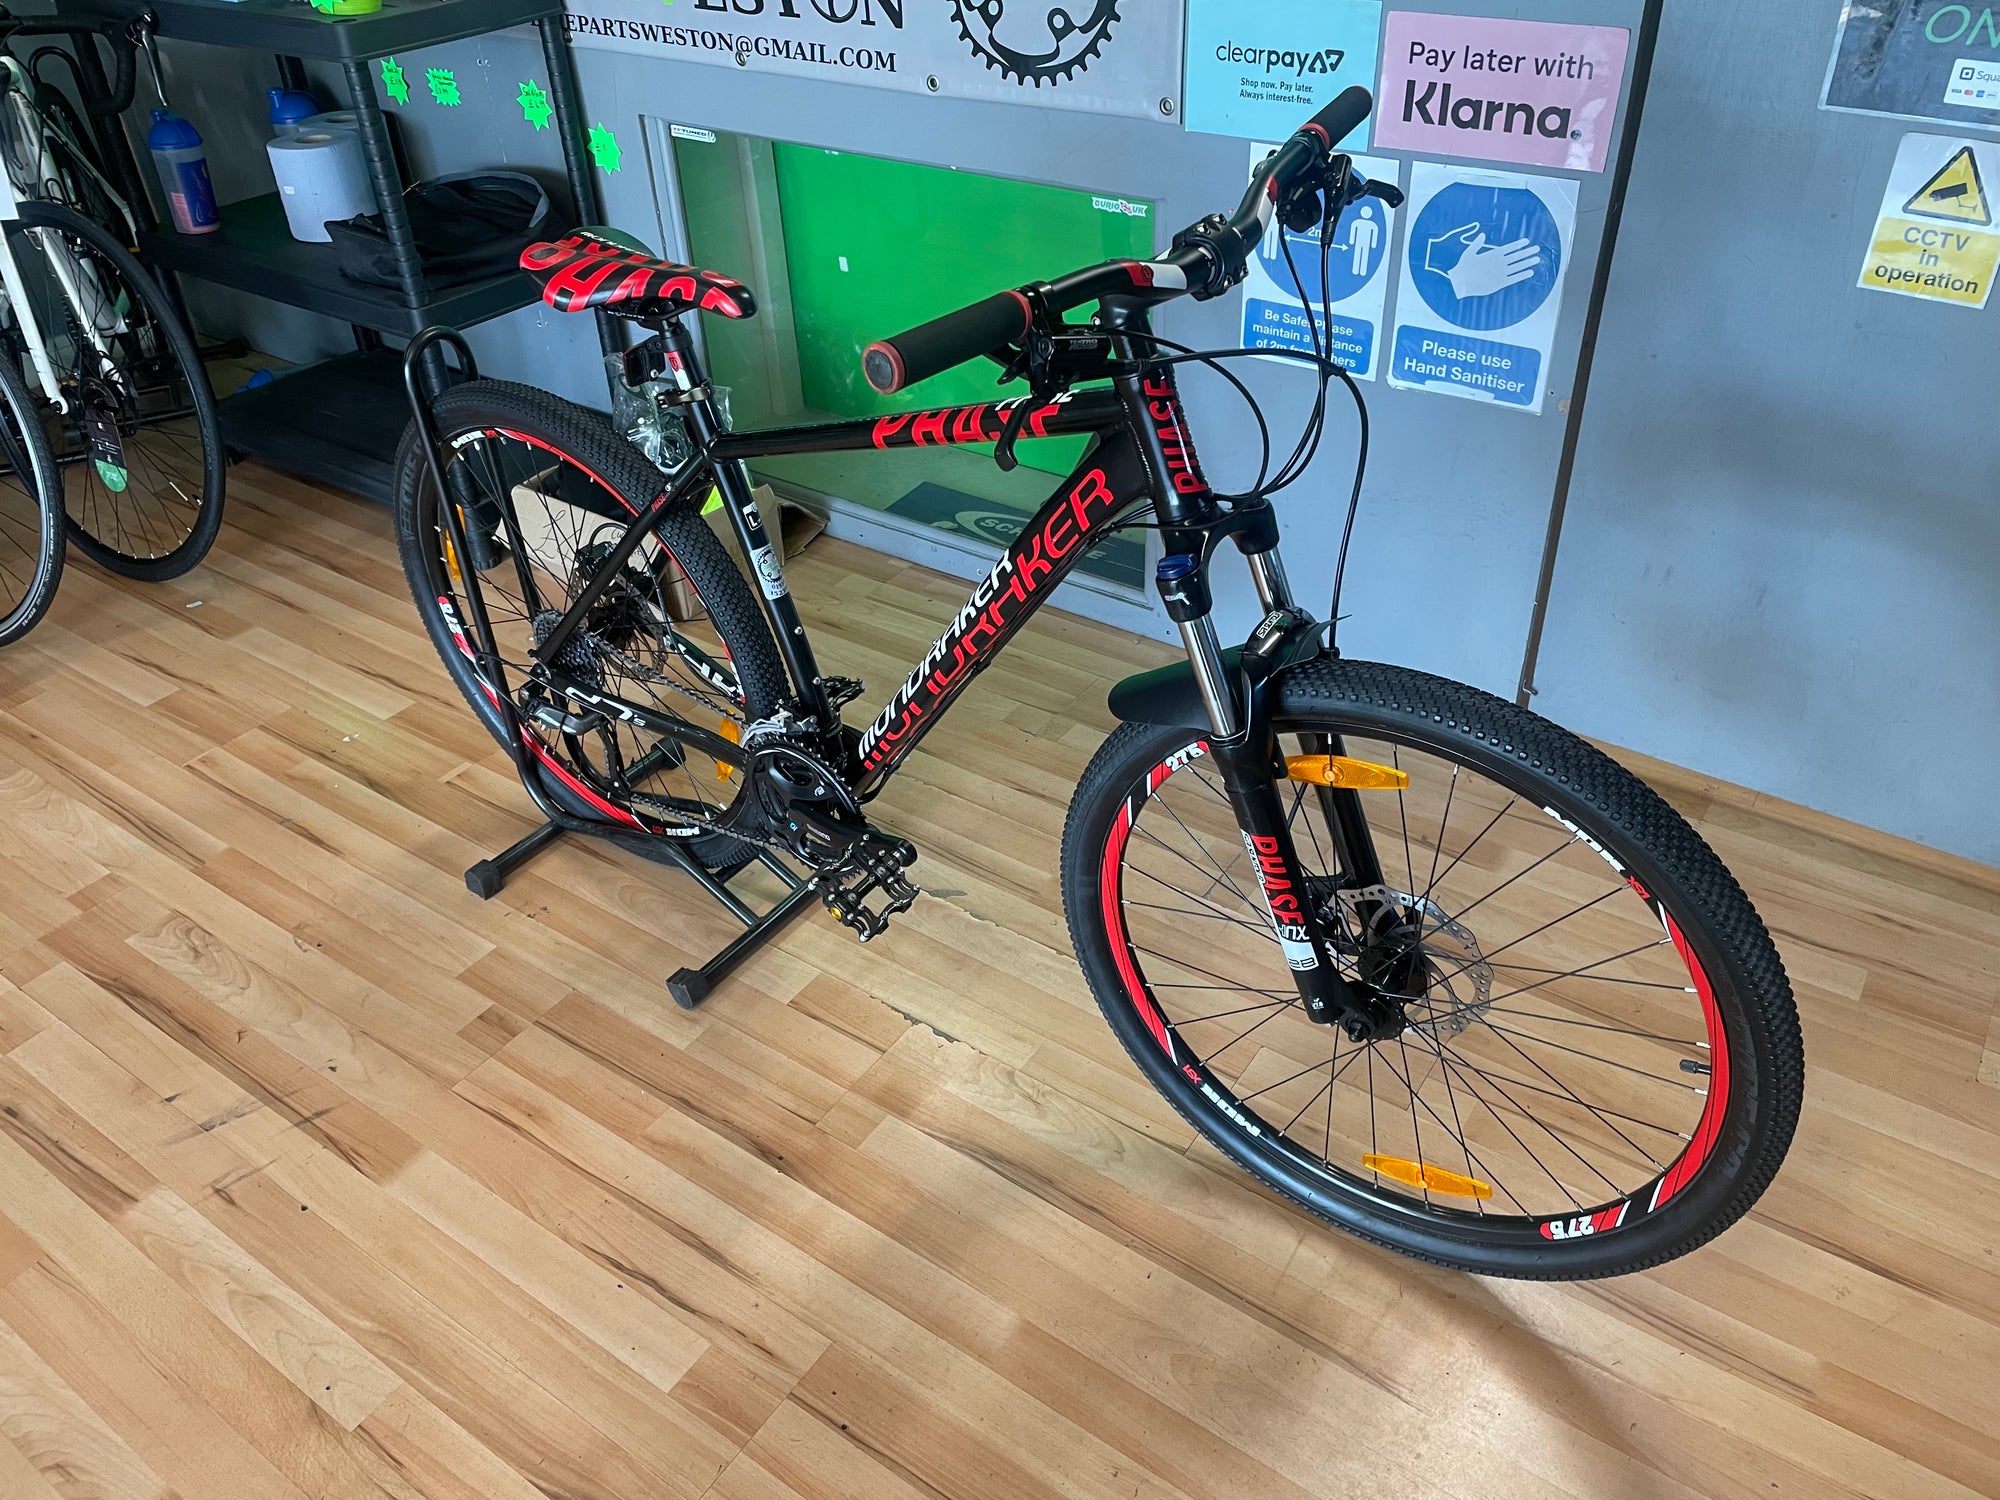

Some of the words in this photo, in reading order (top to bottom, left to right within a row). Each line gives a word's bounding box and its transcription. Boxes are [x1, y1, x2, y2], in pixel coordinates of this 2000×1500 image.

[1216, 40, 1309, 77] clearpay
[1409, 41, 1456, 73] Pay
[1463, 46, 1526, 74] later
[1535, 52, 1594, 80] with
[1241, 77, 1258, 88] Shop
[1261, 81, 1277, 89] now.
[1280, 81, 1293, 92] Pay
[1295, 83, 1313, 93] later.
[1240, 89, 1264, 100] Always
[1266, 92, 1313, 104] interest-free.
[1903, 226, 1970, 251] CCTV
[1919, 250, 1938, 266] in
[1874, 264, 1978, 294] operation
[1264, 309, 1280, 321] Be
[1252, 323, 1300, 341] maintain
[1303, 334, 1310, 343] a
[1256, 339, 1268, 348] of
[1422, 340, 1477, 366] Please
[1481, 352, 1512, 370] use
[1404, 357, 1446, 379] Hand
[1451, 366, 1525, 394] Sanitiser
